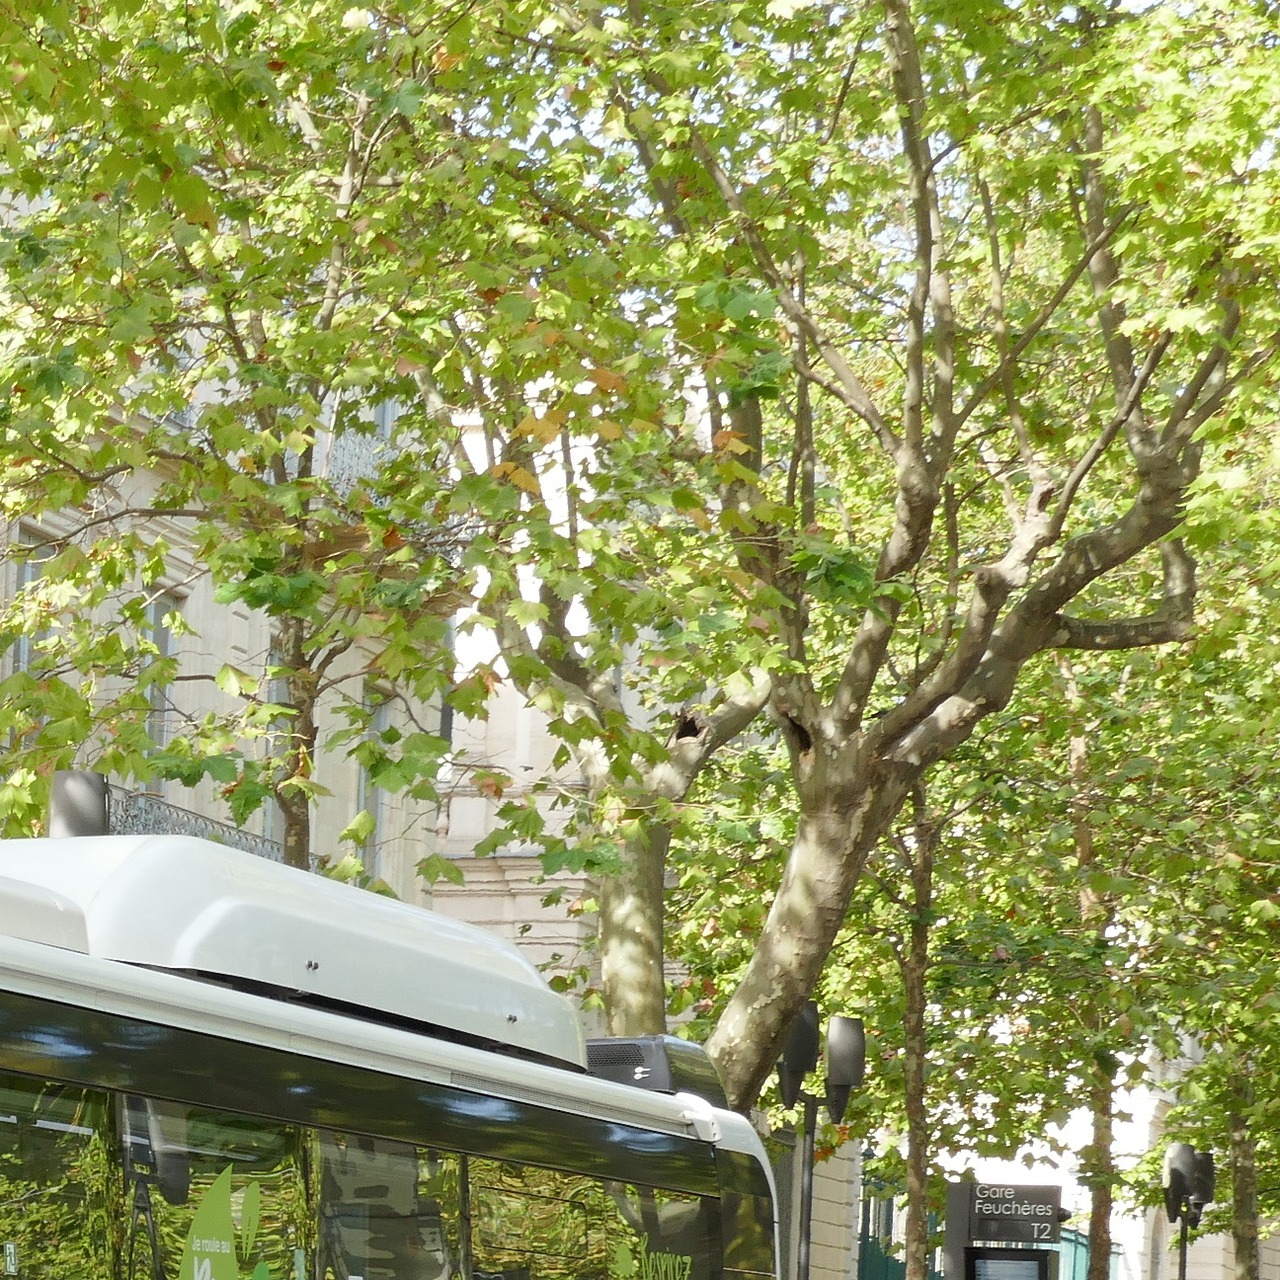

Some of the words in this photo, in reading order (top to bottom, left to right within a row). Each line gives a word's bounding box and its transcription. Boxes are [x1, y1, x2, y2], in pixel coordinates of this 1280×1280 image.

[975, 1184, 1015, 1199] Gare
[974, 1200, 1053, 1216] Feuchères
[1031, 1223, 1052, 1239] T2
[201, 1236, 220, 1252] roule
[221, 1240, 231, 1253] au
